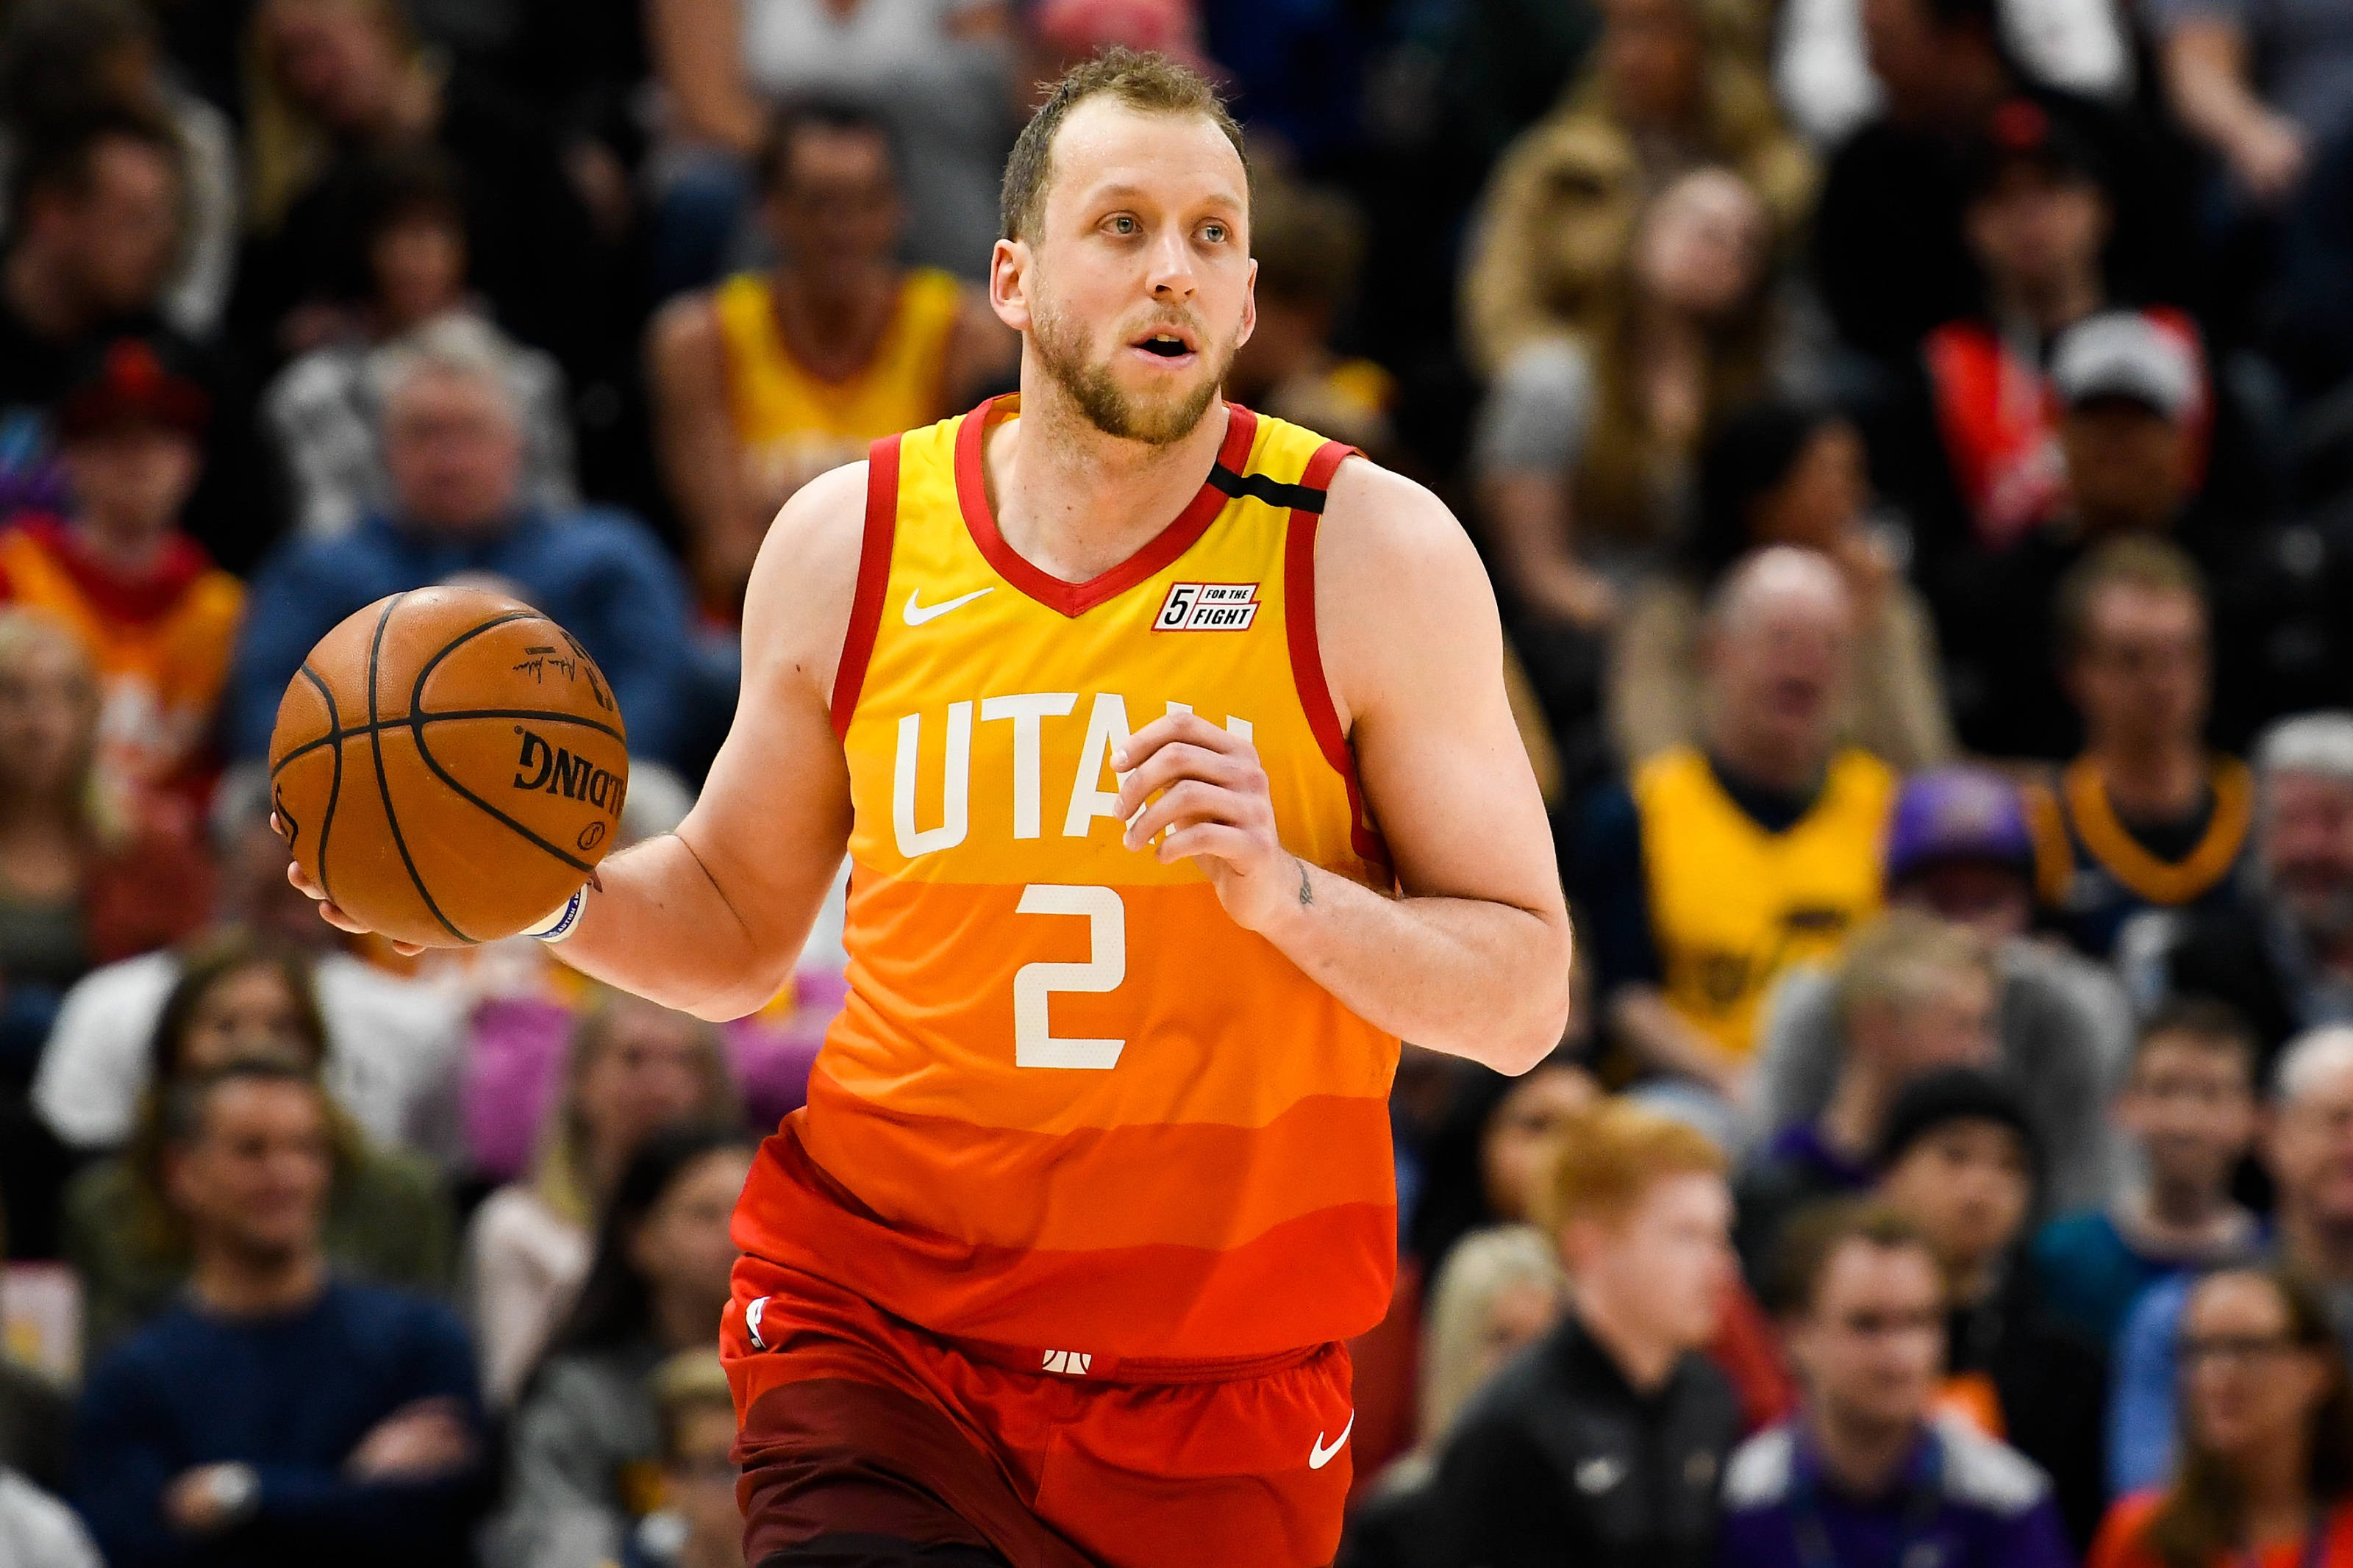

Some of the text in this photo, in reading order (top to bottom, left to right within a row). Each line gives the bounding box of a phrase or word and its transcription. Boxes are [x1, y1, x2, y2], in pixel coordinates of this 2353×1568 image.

[1163, 588, 1195, 625] 5
[1204, 589, 1249, 600] FOR THE
[1192, 608, 1251, 625] FIGHT
[893, 692, 1253, 859] UTA
[557, 906, 576, 932] AUTISM
[1013, 884, 1126, 1070] 2
